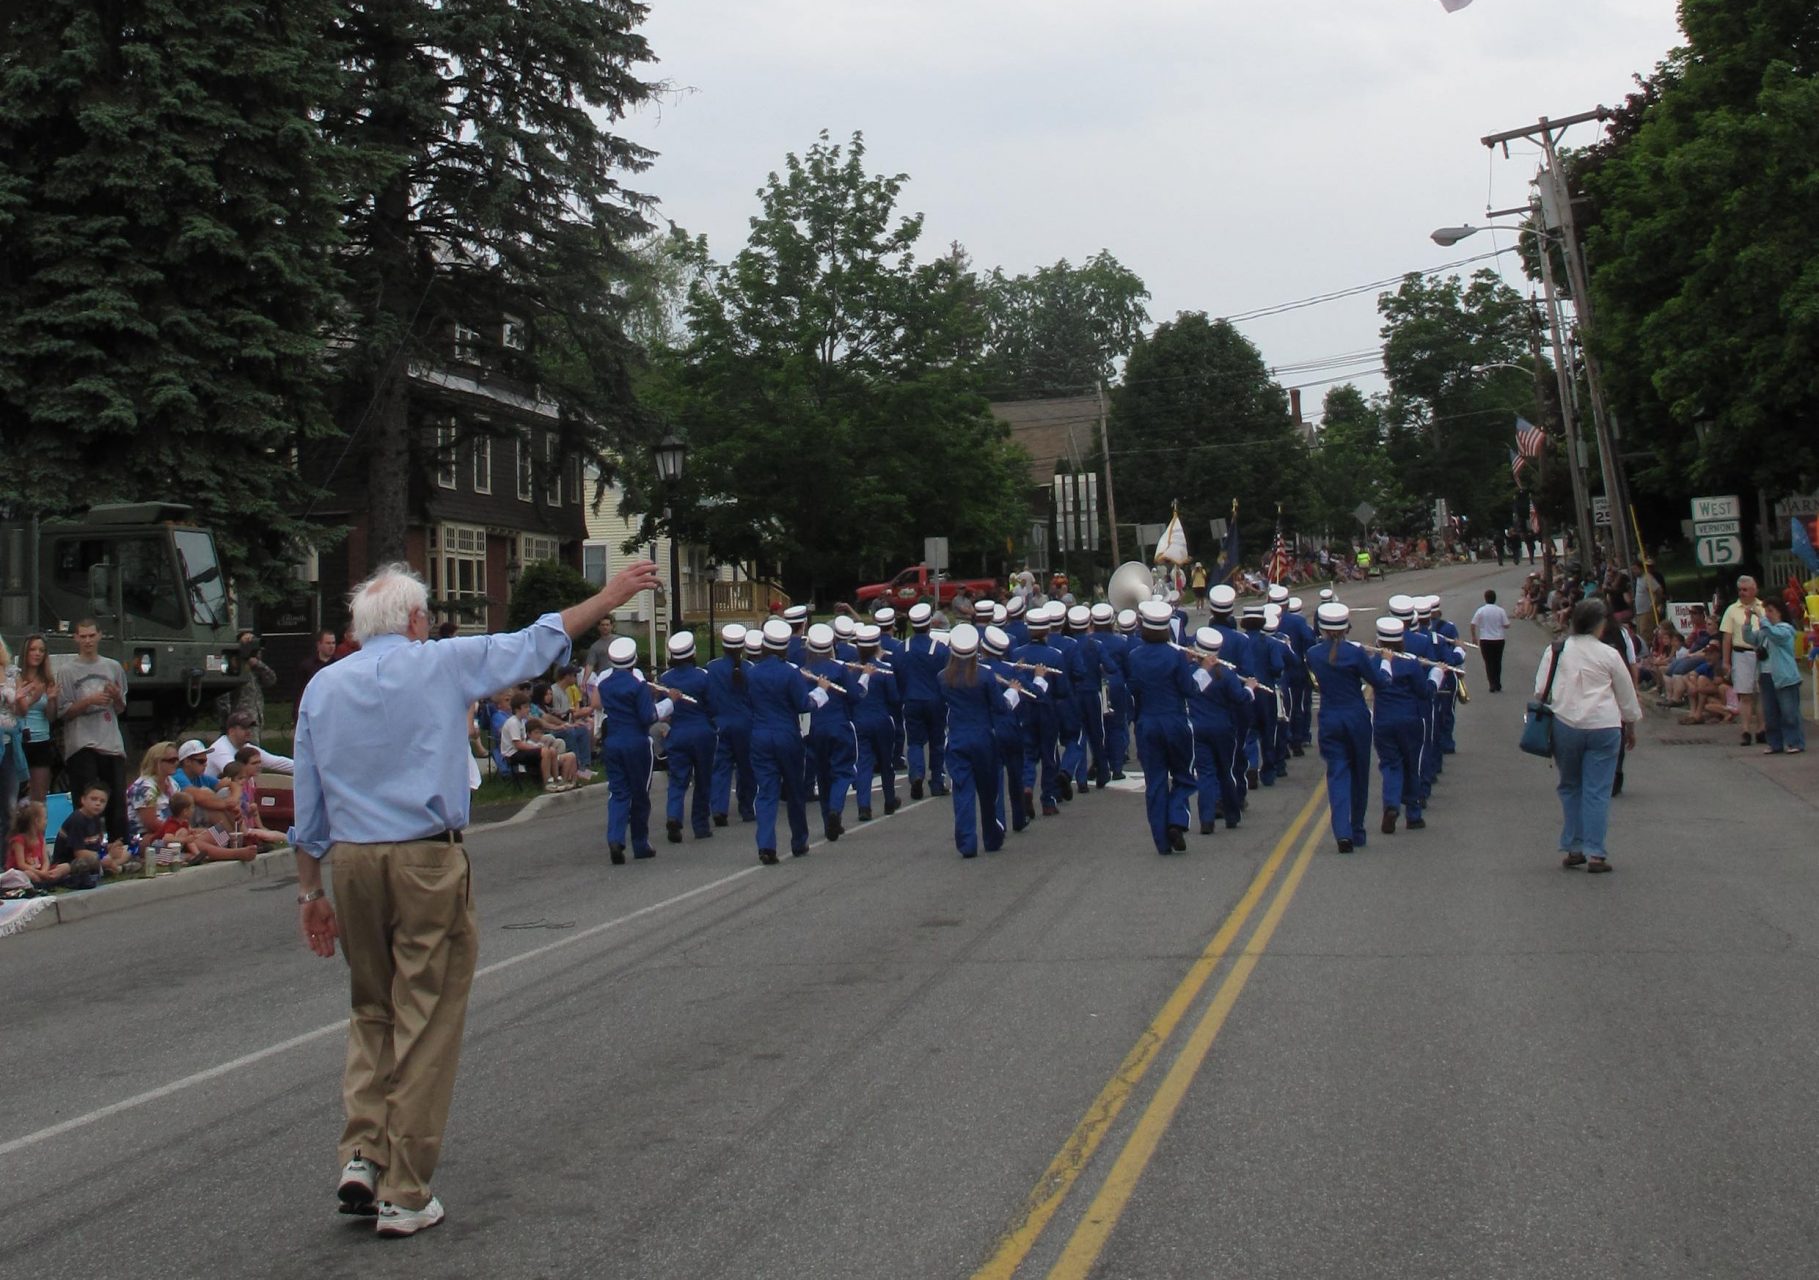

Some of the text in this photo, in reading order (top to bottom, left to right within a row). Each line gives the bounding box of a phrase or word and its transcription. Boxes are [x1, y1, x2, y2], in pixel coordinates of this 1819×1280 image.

[1699, 502, 1732, 516] WEST
[1595, 511, 1611, 523] 25
[1699, 523, 1736, 534] VERMONT
[1706, 538, 1733, 564] 15
